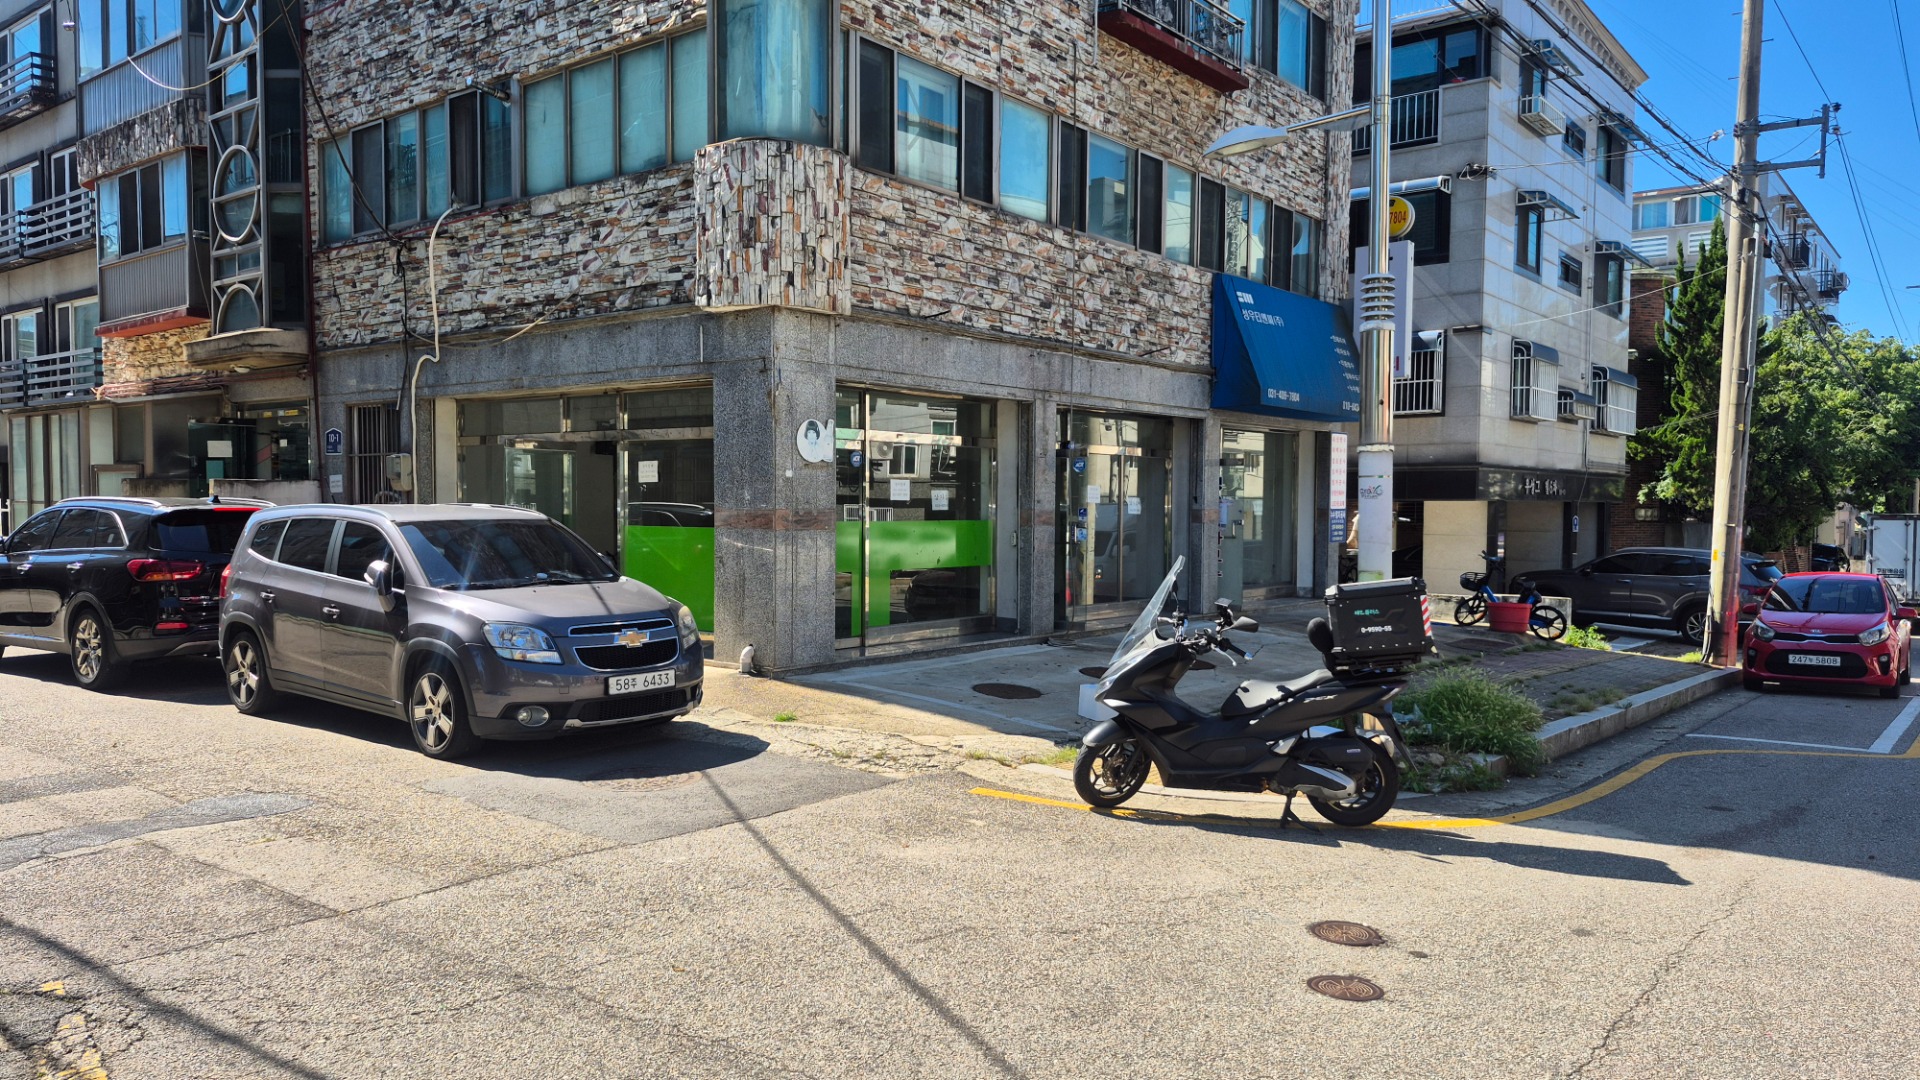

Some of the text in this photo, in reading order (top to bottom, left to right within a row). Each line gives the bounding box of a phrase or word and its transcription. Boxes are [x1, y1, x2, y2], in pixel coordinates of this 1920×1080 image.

[328, 433, 339, 443] 10-1
[615, 672, 670, 691] 58주 6433
